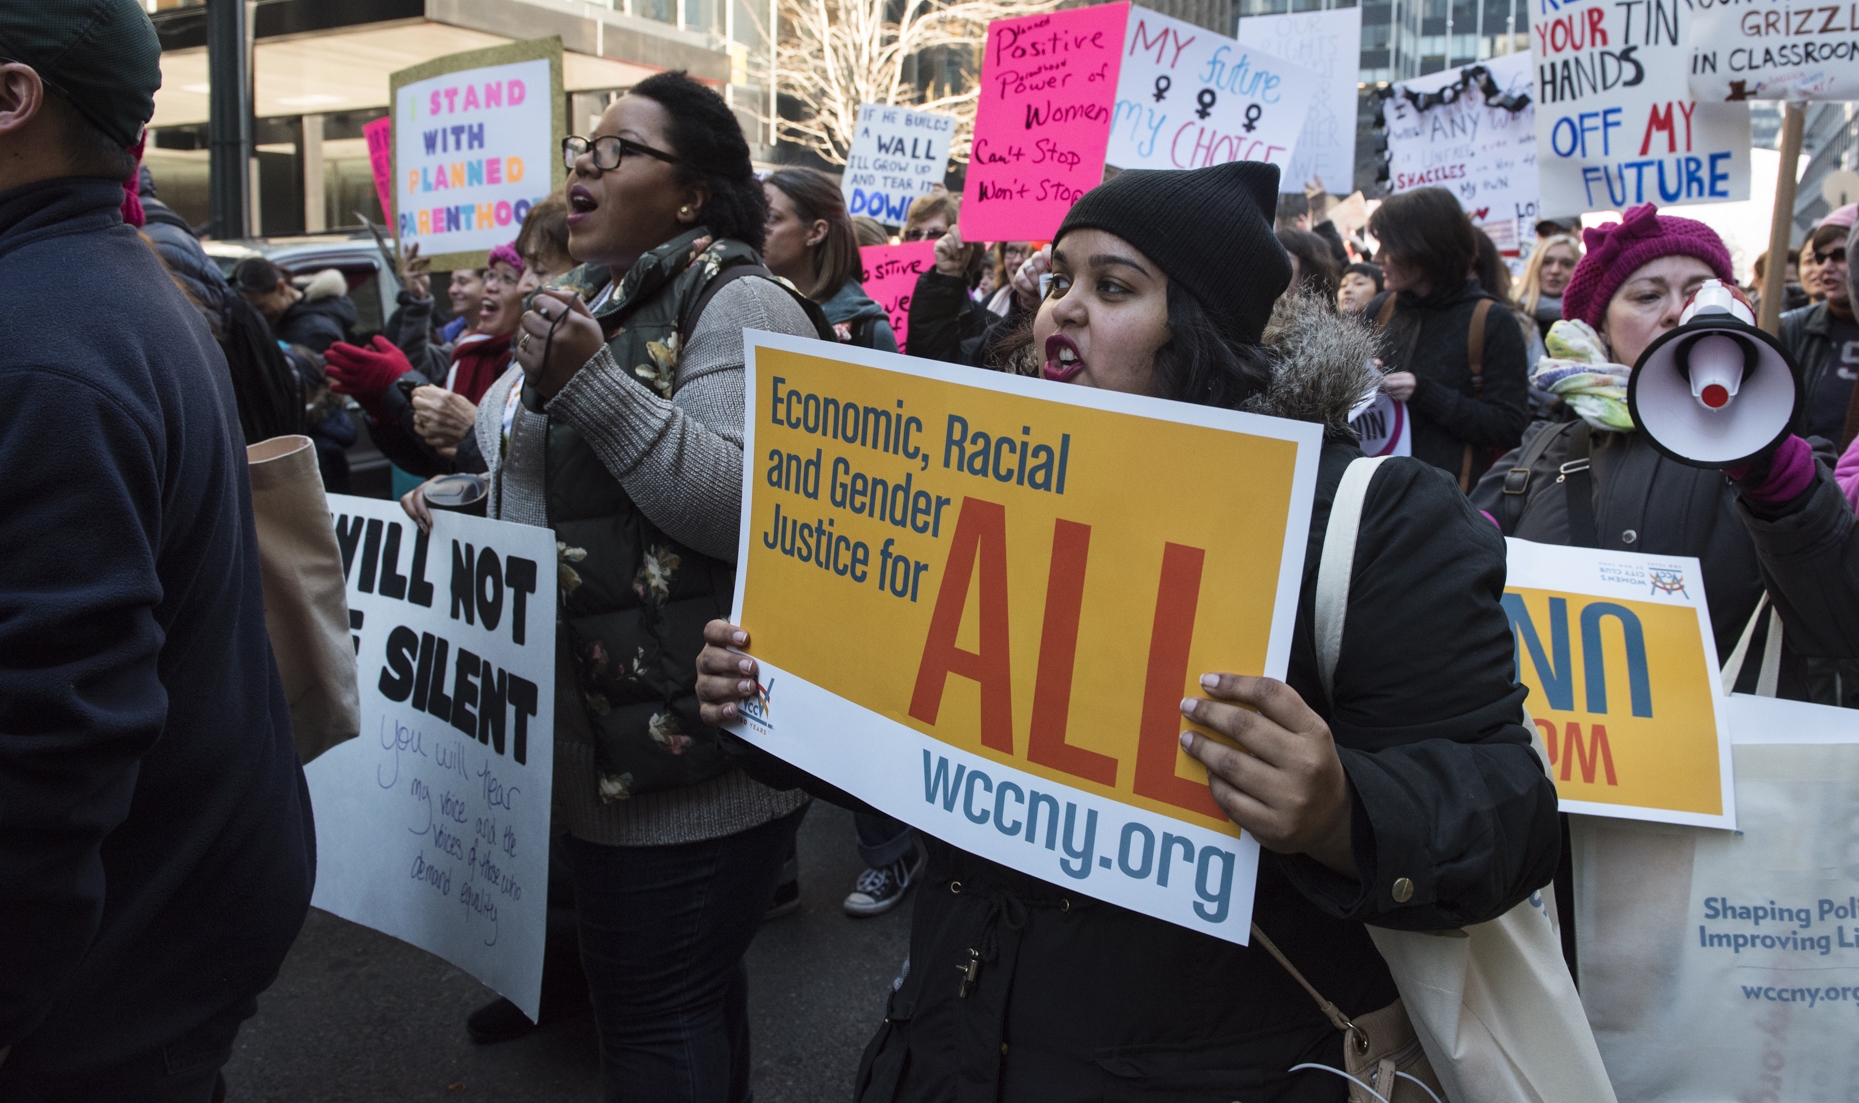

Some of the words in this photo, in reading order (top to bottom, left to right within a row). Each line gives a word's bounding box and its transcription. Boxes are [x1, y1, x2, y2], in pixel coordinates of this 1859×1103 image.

[996, 27, 1104, 67] Positive
[1535, 8, 1609, 57] YOUR
[1616, 1, 1694, 46] TIN
[995, 70, 1073, 100] Power
[1088, 62, 1108, 82] of
[1129, 20, 1196, 69] MY
[1198, 45, 1281, 103] future
[1540, 46, 1645, 104] HANDS
[410, 96, 416, 122] I
[429, 78, 527, 116] STAND
[863, 108, 876, 122] IF
[882, 110, 898, 124] HE
[904, 113, 950, 132] BUILDS
[1025, 100, 1110, 129] Women
[423, 122, 485, 156] WITH
[861, 126, 870, 138] A
[1109, 101, 1167, 158] my
[1431, 111, 1480, 142] ANY
[1552, 107, 1623, 158] OFF
[1639, 101, 1697, 156] MY
[873, 158, 910, 172] GROW
[915, 164, 931, 176] UP
[877, 134, 937, 161] WALL
[975, 139, 1025, 165] Can't
[1032, 138, 1081, 171] Stop
[408, 155, 525, 195] PLANNED
[851, 173, 876, 186] AND
[882, 176, 913, 191] TEAR
[979, 178, 1030, 203] Won't
[1397, 164, 1466, 190] SHACKLES
[1582, 152, 1732, 207] FUTURE
[400, 198, 546, 239] PARENTHOO
[1515, 200, 1539, 218] LO
[771, 376, 930, 471] Economic,
[942, 412, 1071, 495] Racial
[766, 447, 820, 500] and
[830, 456, 951, 538] Gender
[763, 502, 869, 585] Justice
[878, 535, 929, 602] for
[451, 538, 537, 646] NOT
[908, 495, 1232, 823] ALL
[378, 625, 538, 766] SILENT
[750, 722, 767, 736] YEARS
[436, 741, 469, 781] will
[477, 760, 521, 811] hear
[408, 778, 433, 835] my
[441, 794, 468, 824] voice
[476, 817, 497, 846] and
[503, 825, 517, 858] the
[922, 748, 1236, 924] wccny.org
[479, 852, 500, 886] those
[501, 874, 522, 902] who
[411, 850, 452, 897] demand
[460, 882, 498, 947] equality
[1704, 897, 1811, 929] Shaping
[1818, 896, 1859, 922] Pol
[1699, 925, 1831, 955] Improving
[1741, 984, 1859, 1008] wccny.org
